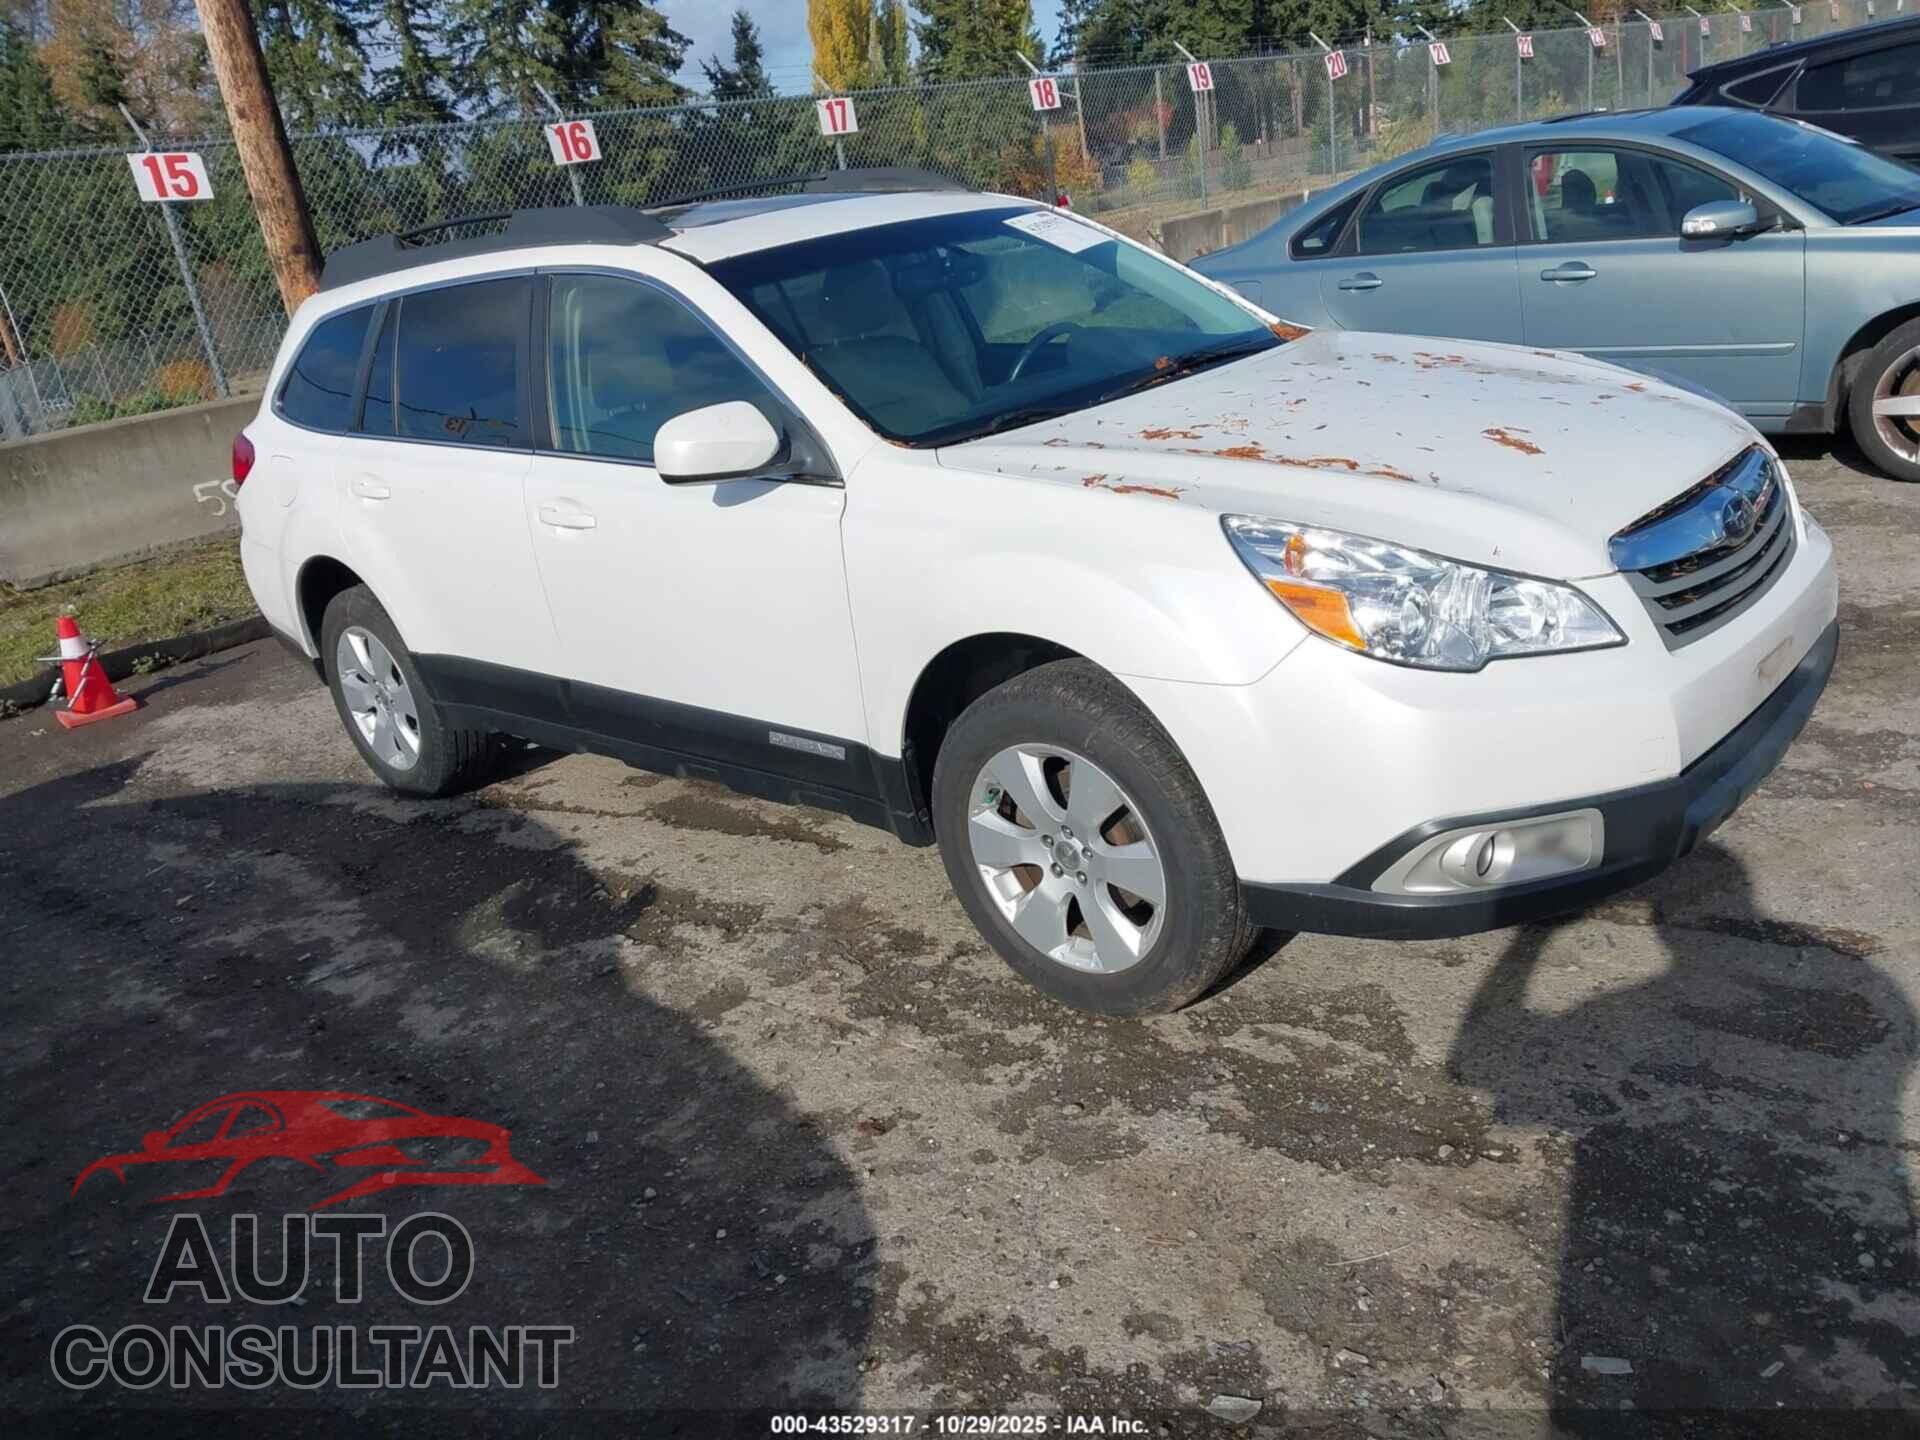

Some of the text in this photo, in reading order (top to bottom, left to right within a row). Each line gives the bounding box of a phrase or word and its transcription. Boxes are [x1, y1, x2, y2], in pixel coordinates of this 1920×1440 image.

[1327, 52, 1345, 77] 20
[1432, 43, 1448, 63] 21
[1191, 63, 1209, 88] 19
[1034, 79, 1056, 107] 18
[825, 100, 848, 132] 17
[553, 122, 592, 161] 16
[143, 155, 199, 198] 15
